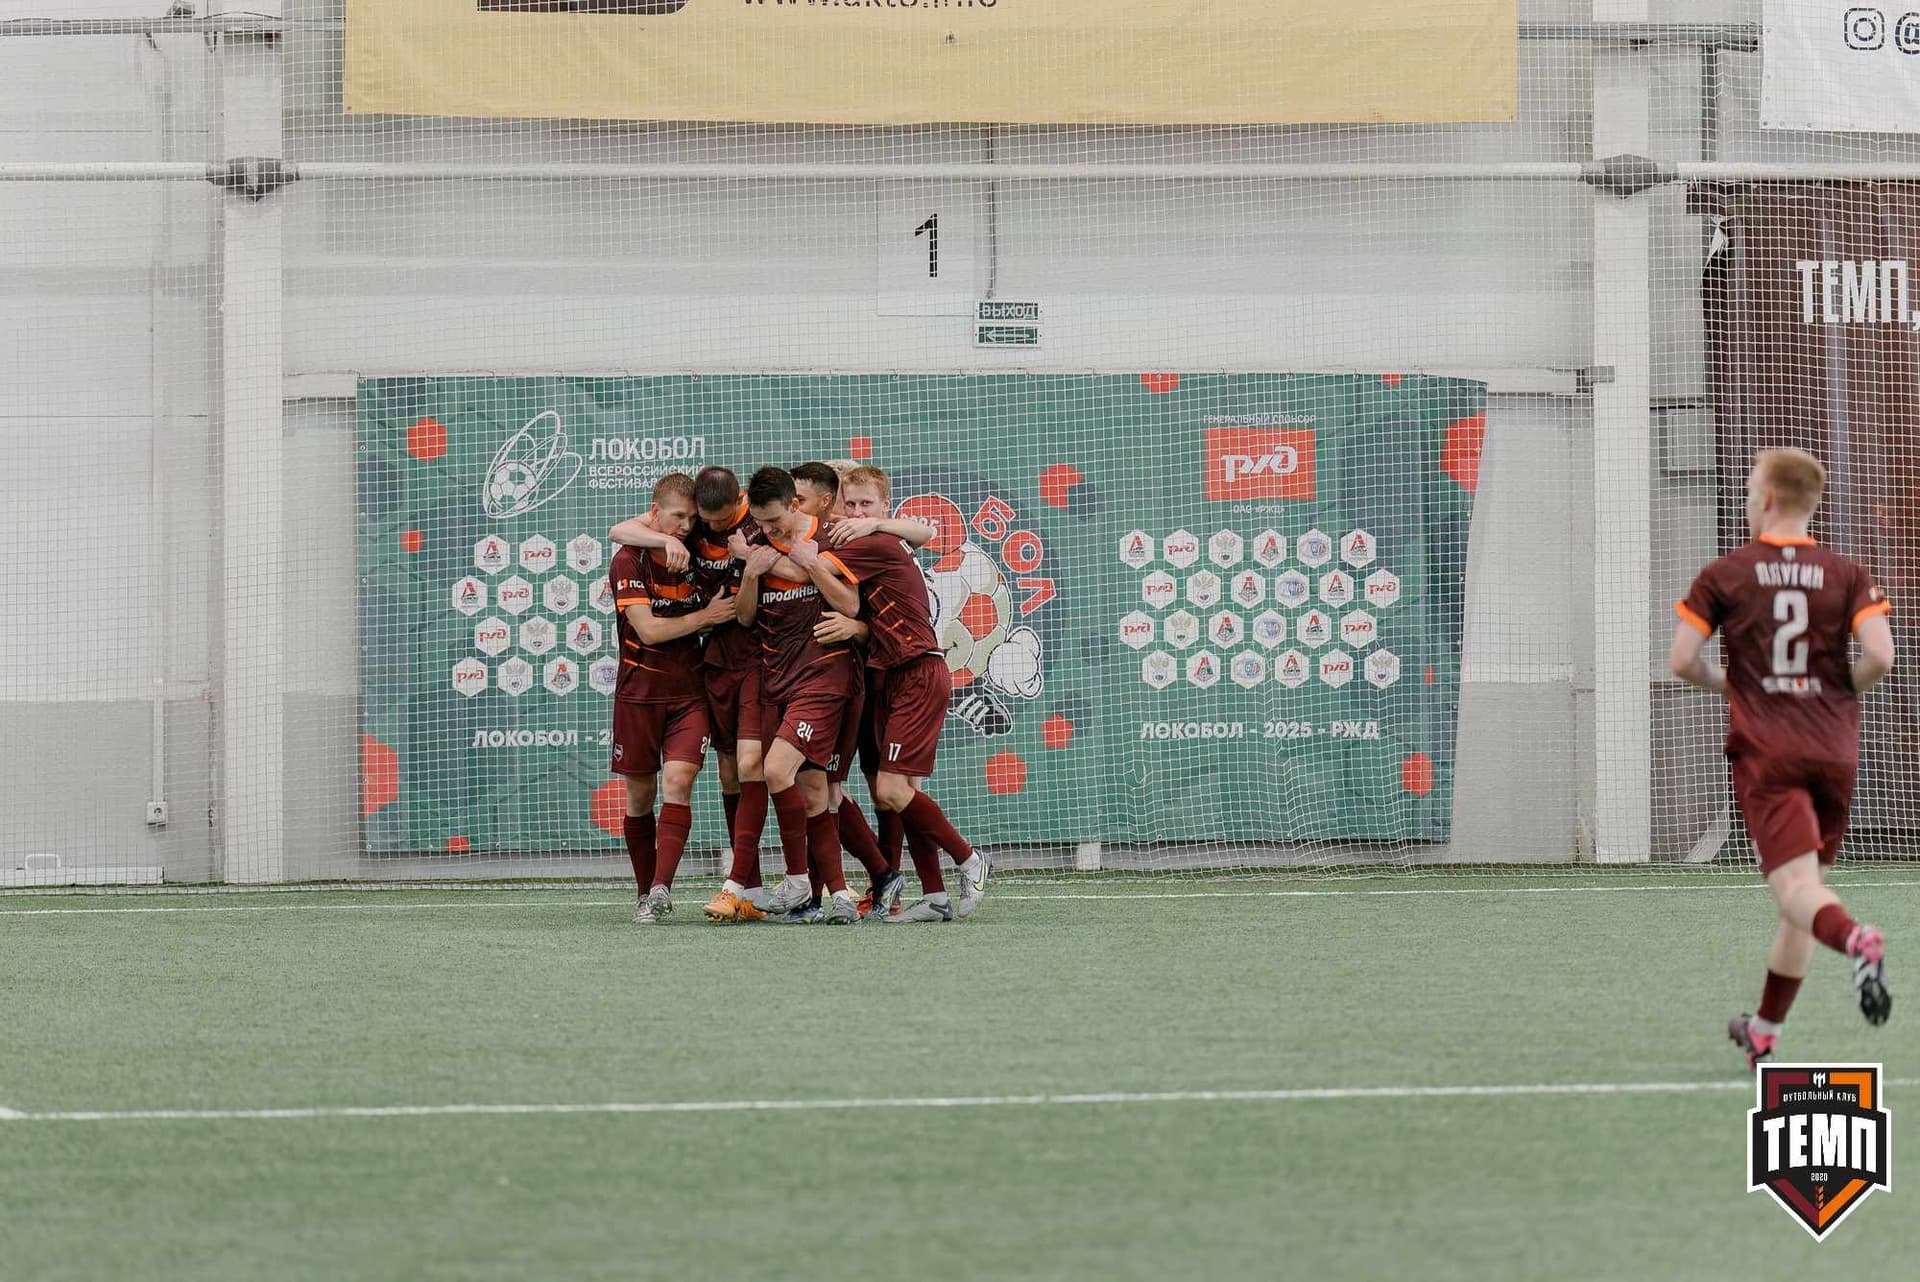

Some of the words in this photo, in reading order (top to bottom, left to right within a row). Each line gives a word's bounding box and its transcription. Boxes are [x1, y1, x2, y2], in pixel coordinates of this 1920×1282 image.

[914, 212, 938, 278] 1
[981, 304, 1036, 319] ВЫХОД
[588, 437, 706, 461] ЛОКОБОЛ
[1772, 588, 1809, 676] 2
[472, 729, 578, 747] ЛОКОБОЛ
[796, 721, 814, 743] 24
[1140, 721, 1244, 739] ЛОКОБОЛ
[1264, 721, 1312, 738] 2025
[1332, 720, 1380, 739] РЖД
[888, 742, 902, 763] 17
